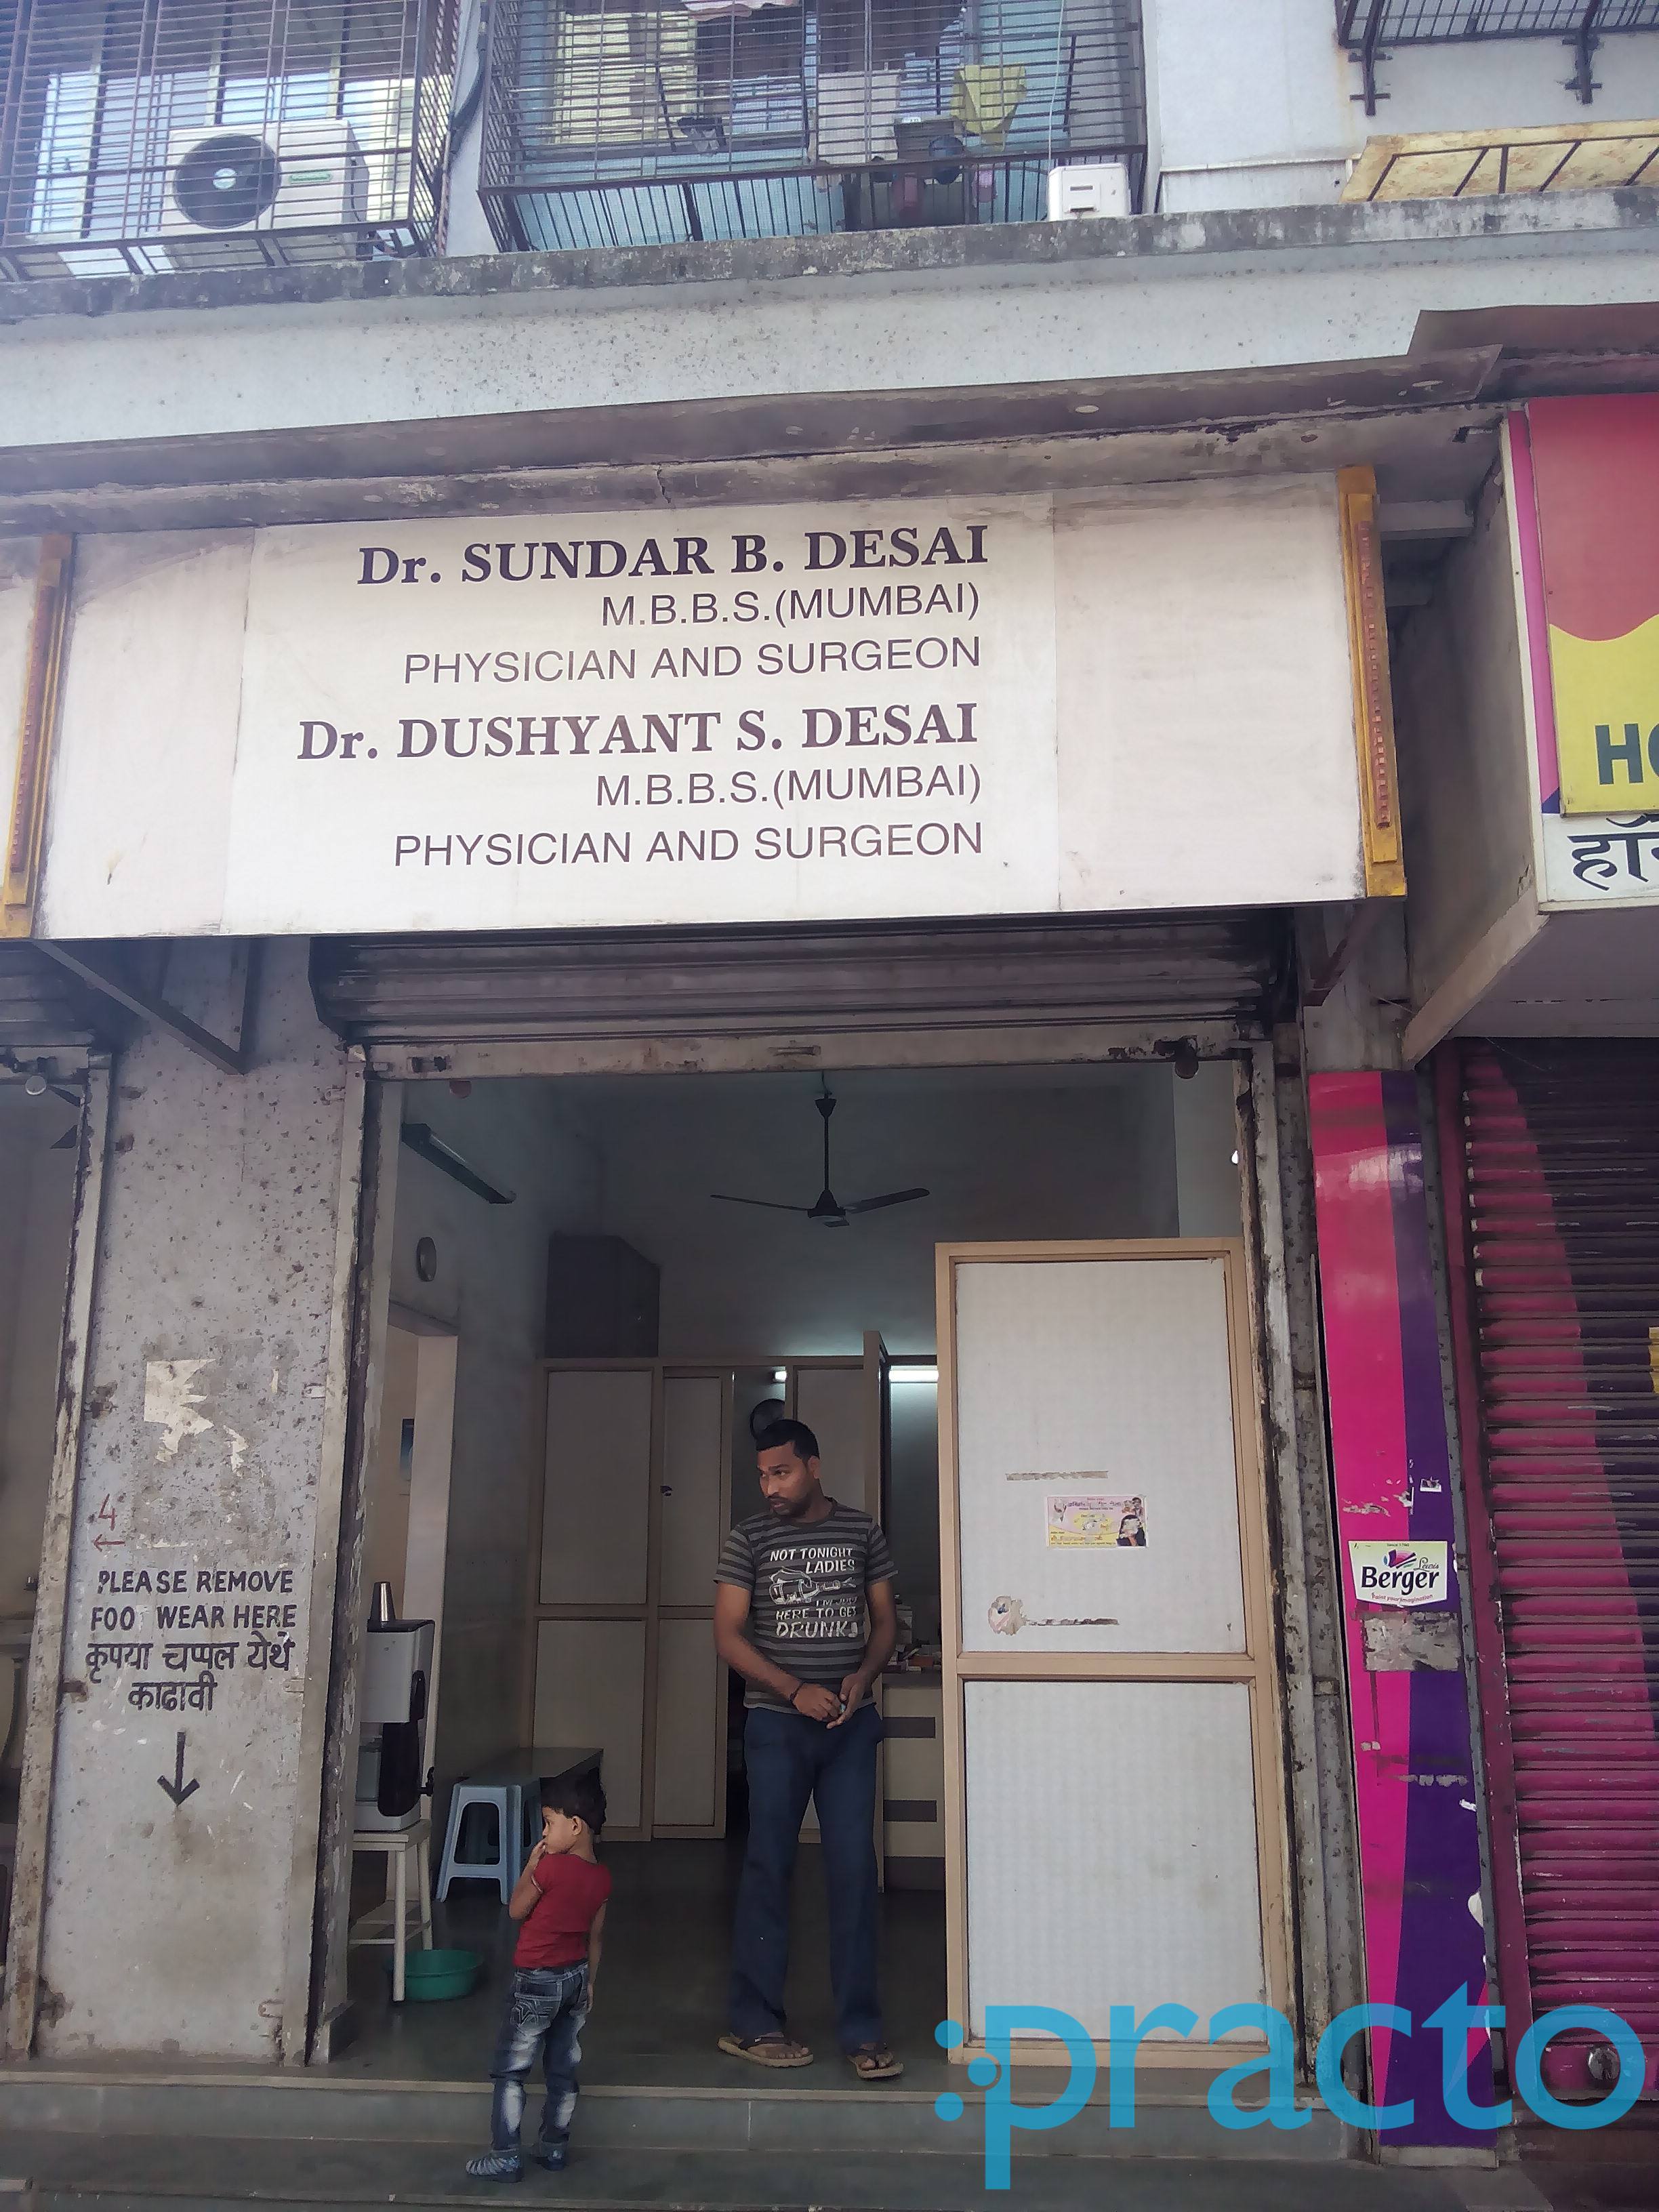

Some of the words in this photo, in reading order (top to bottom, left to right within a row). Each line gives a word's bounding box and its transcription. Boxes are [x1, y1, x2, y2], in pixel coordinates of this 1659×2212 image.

[357, 547, 441, 585] Dr.
[462, 537, 714, 582] SUNDAR
[731, 534, 783, 573] B.
[804, 525, 987, 571] DESAI
[603, 582, 979, 629] M.B.B.S.(MUMBAI)
[405, 649, 635, 684] PHYSICIAN
[651, 646, 741, 679] AND
[758, 636, 979, 675] SURGEON
[298, 720, 377, 760] Dr.
[397, 712, 720, 758] DUSHYANT
[737, 710, 781, 751] S.
[802, 703, 977, 748] DESAI
[1595, 722, 1659, 785] H
[598, 764, 980, 811] M.B.B.S.(MUMBAI)
[396, 832, 630, 867] PHYSICIAN
[646, 830, 738, 863] AND
[755, 822, 981, 860] SURGEON
[98, 1493, 118, 1531] 4
[770, 1549, 796, 1561] NOT
[800, 1547, 853, 1559] TONIGHT
[805, 1559, 855, 1574] LADIES
[1414, 1557, 1439, 1572] Lewis
[97, 1570, 188, 1595] PLEASE
[196, 1570, 293, 1594] REMOVE
[1361, 1565, 1439, 1595] Berger
[157, 1605, 224, 1630] WEAR
[233, 1603, 298, 1629] HERE
[776, 1607, 810, 1620] HERE
[815, 1607, 834, 1619] TO
[839, 1605, 857, 1618] GET
[85, 1642, 154, 1683] कृपया
[161, 1641, 240, 1673] चप्पल
[247, 1630, 296, 1671] येथे
[127, 1670, 218, 1711] काढावी
